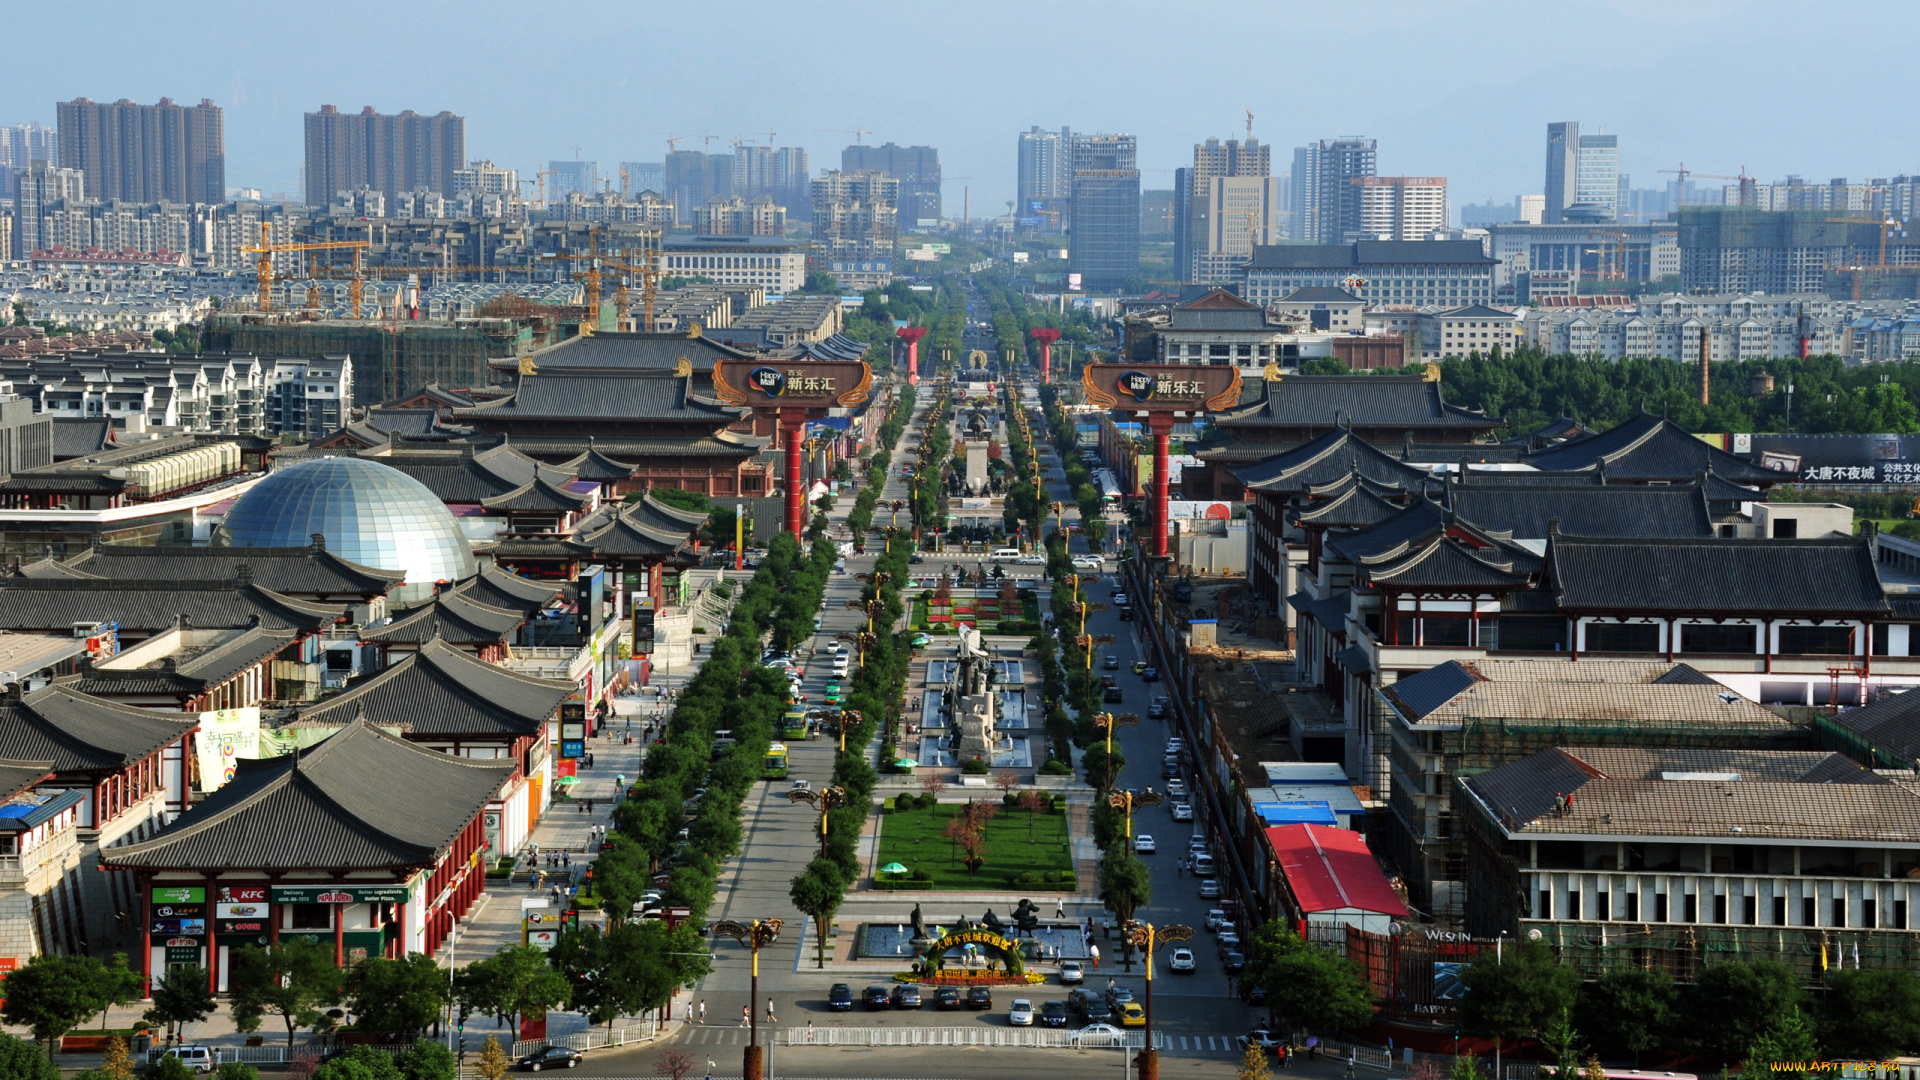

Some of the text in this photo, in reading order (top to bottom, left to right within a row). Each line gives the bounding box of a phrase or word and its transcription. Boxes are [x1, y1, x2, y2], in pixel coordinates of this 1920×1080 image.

[832, 263, 886, 272] 曲江观邸
[760, 371, 781, 380] Happy
[788, 369, 803, 377] 西安
[787, 377, 836, 390] 新乐汇
[1131, 375, 1151, 384] Happy
[1131, 382, 1146, 390] Mall
[1157, 380, 1205, 394] 新乐汇
[1804, 466, 1876, 480] 大唐不夜城
[241, 890, 265, 899] KFC
[318, 893, 333, 902] PAPA
[1424, 929, 1471, 942] WESTIN
[937, 931, 1009, 951] 大唐不夜城欢迎您
[1414, 1004, 1447, 1014] HAPPY
